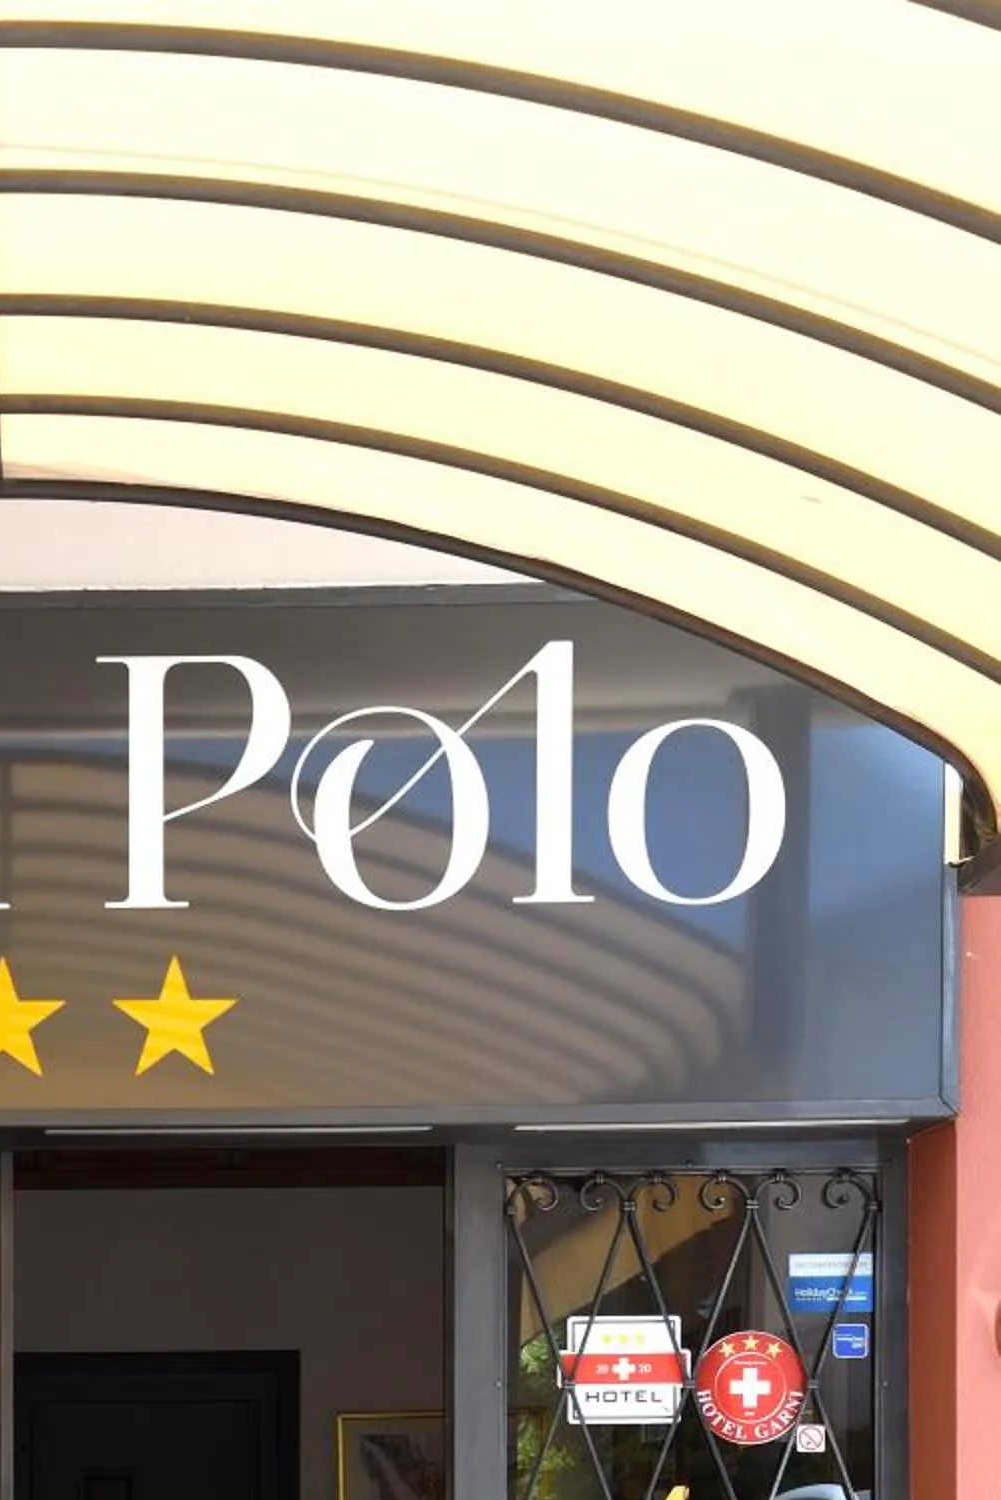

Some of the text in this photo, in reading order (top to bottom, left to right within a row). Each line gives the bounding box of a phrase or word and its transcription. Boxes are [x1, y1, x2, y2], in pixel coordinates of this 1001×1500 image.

[95, 640, 787, 912] Polo
[585, 1390, 662, 1403] HOTEL
[696, 1389, 804, 1440] HOTEL GARNI
